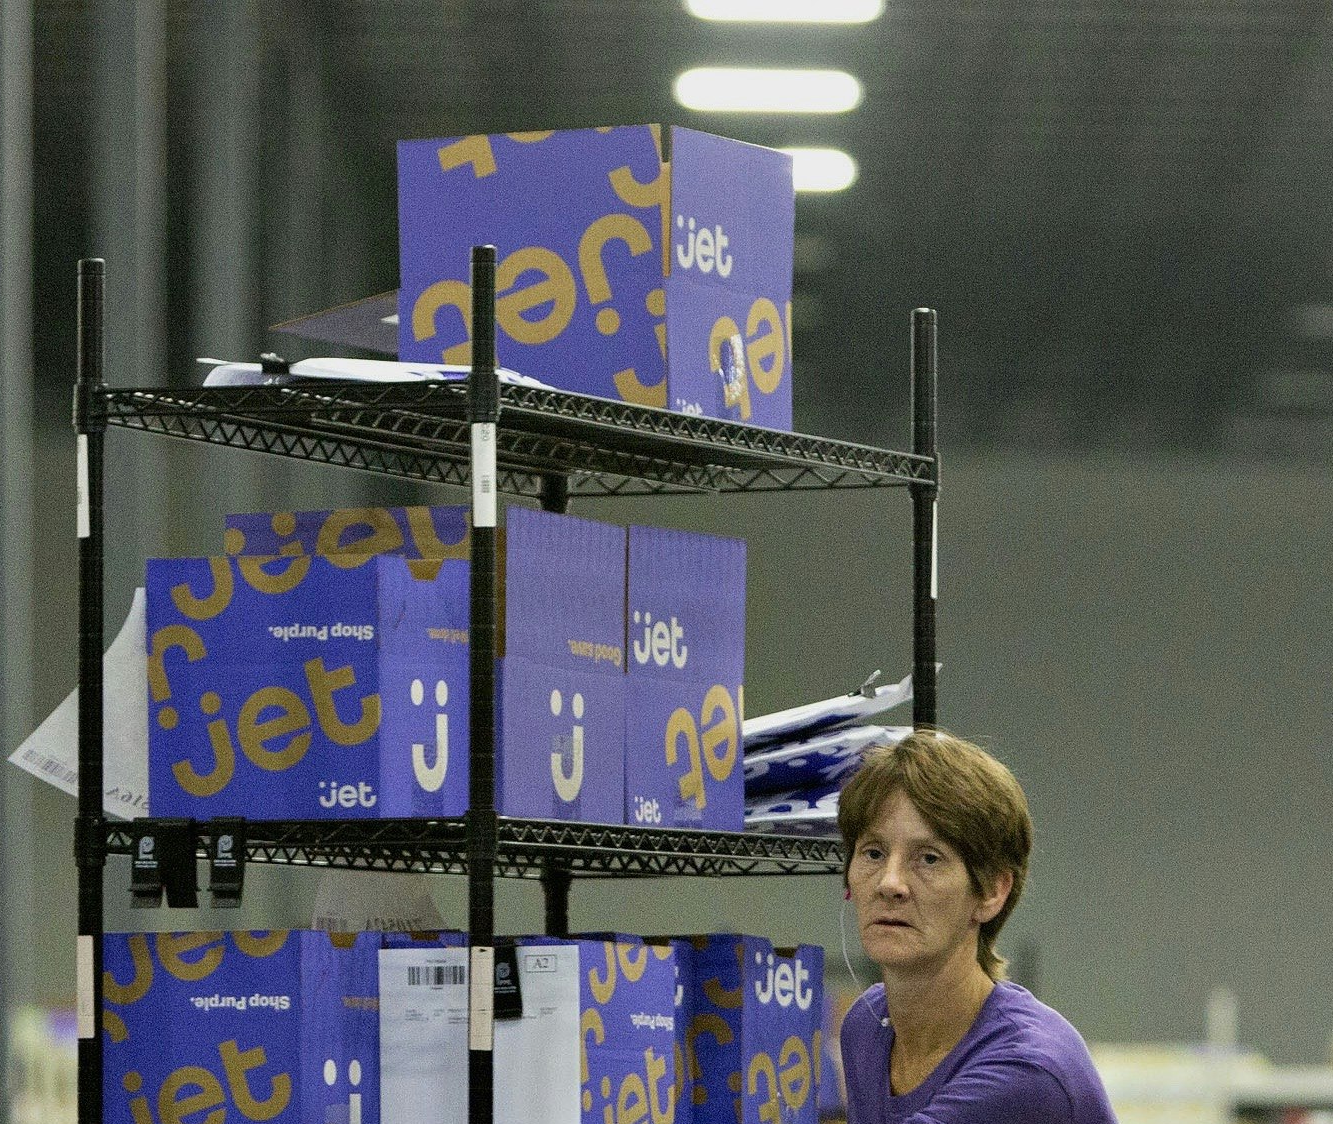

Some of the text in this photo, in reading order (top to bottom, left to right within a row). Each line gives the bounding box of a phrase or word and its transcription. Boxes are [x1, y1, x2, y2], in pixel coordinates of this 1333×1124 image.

[677, 215, 732, 278] jet
[709, 297, 792, 420] et
[268, 625, 374, 642] Shop Purple.
[633, 610, 688, 669] jet
[172, 658, 382, 797] jet
[666, 684, 744, 810] et
[319, 781, 376, 808] jet
[634, 796, 661, 824] jet
[190, 996, 290, 1011] Shop Purple.
[755, 953, 813, 1009] jet
